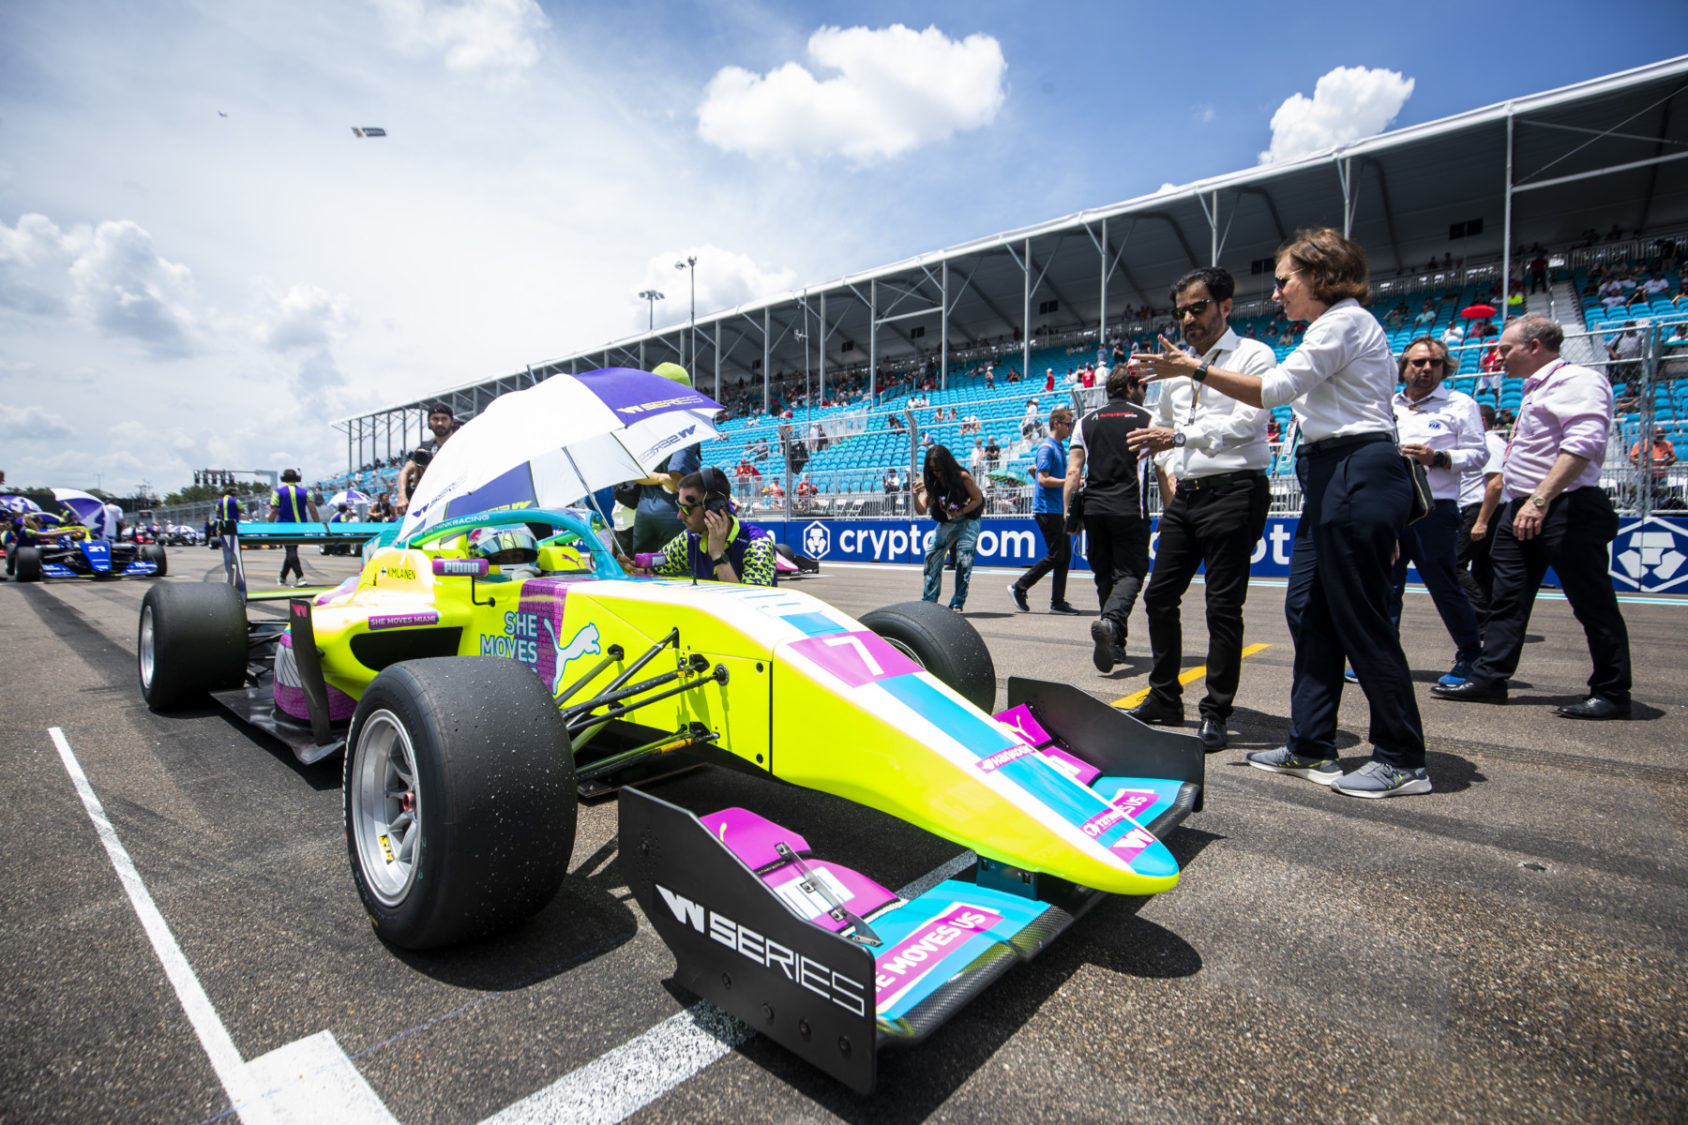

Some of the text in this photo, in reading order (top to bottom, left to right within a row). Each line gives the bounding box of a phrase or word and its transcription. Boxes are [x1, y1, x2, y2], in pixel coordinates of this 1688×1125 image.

[616, 395, 704, 414] W SERIES
[443, 561, 480, 574] PUMA
[370, 615, 436, 626] SHE MOVES MIAMI
[504, 611, 538, 638] SHE
[480, 634, 538, 664] MOVES
[822, 635, 885, 677] 7
[655, 884, 705, 934] W
[709, 910, 865, 1018] SERIES
[881, 911, 987, 976] MOVES US
